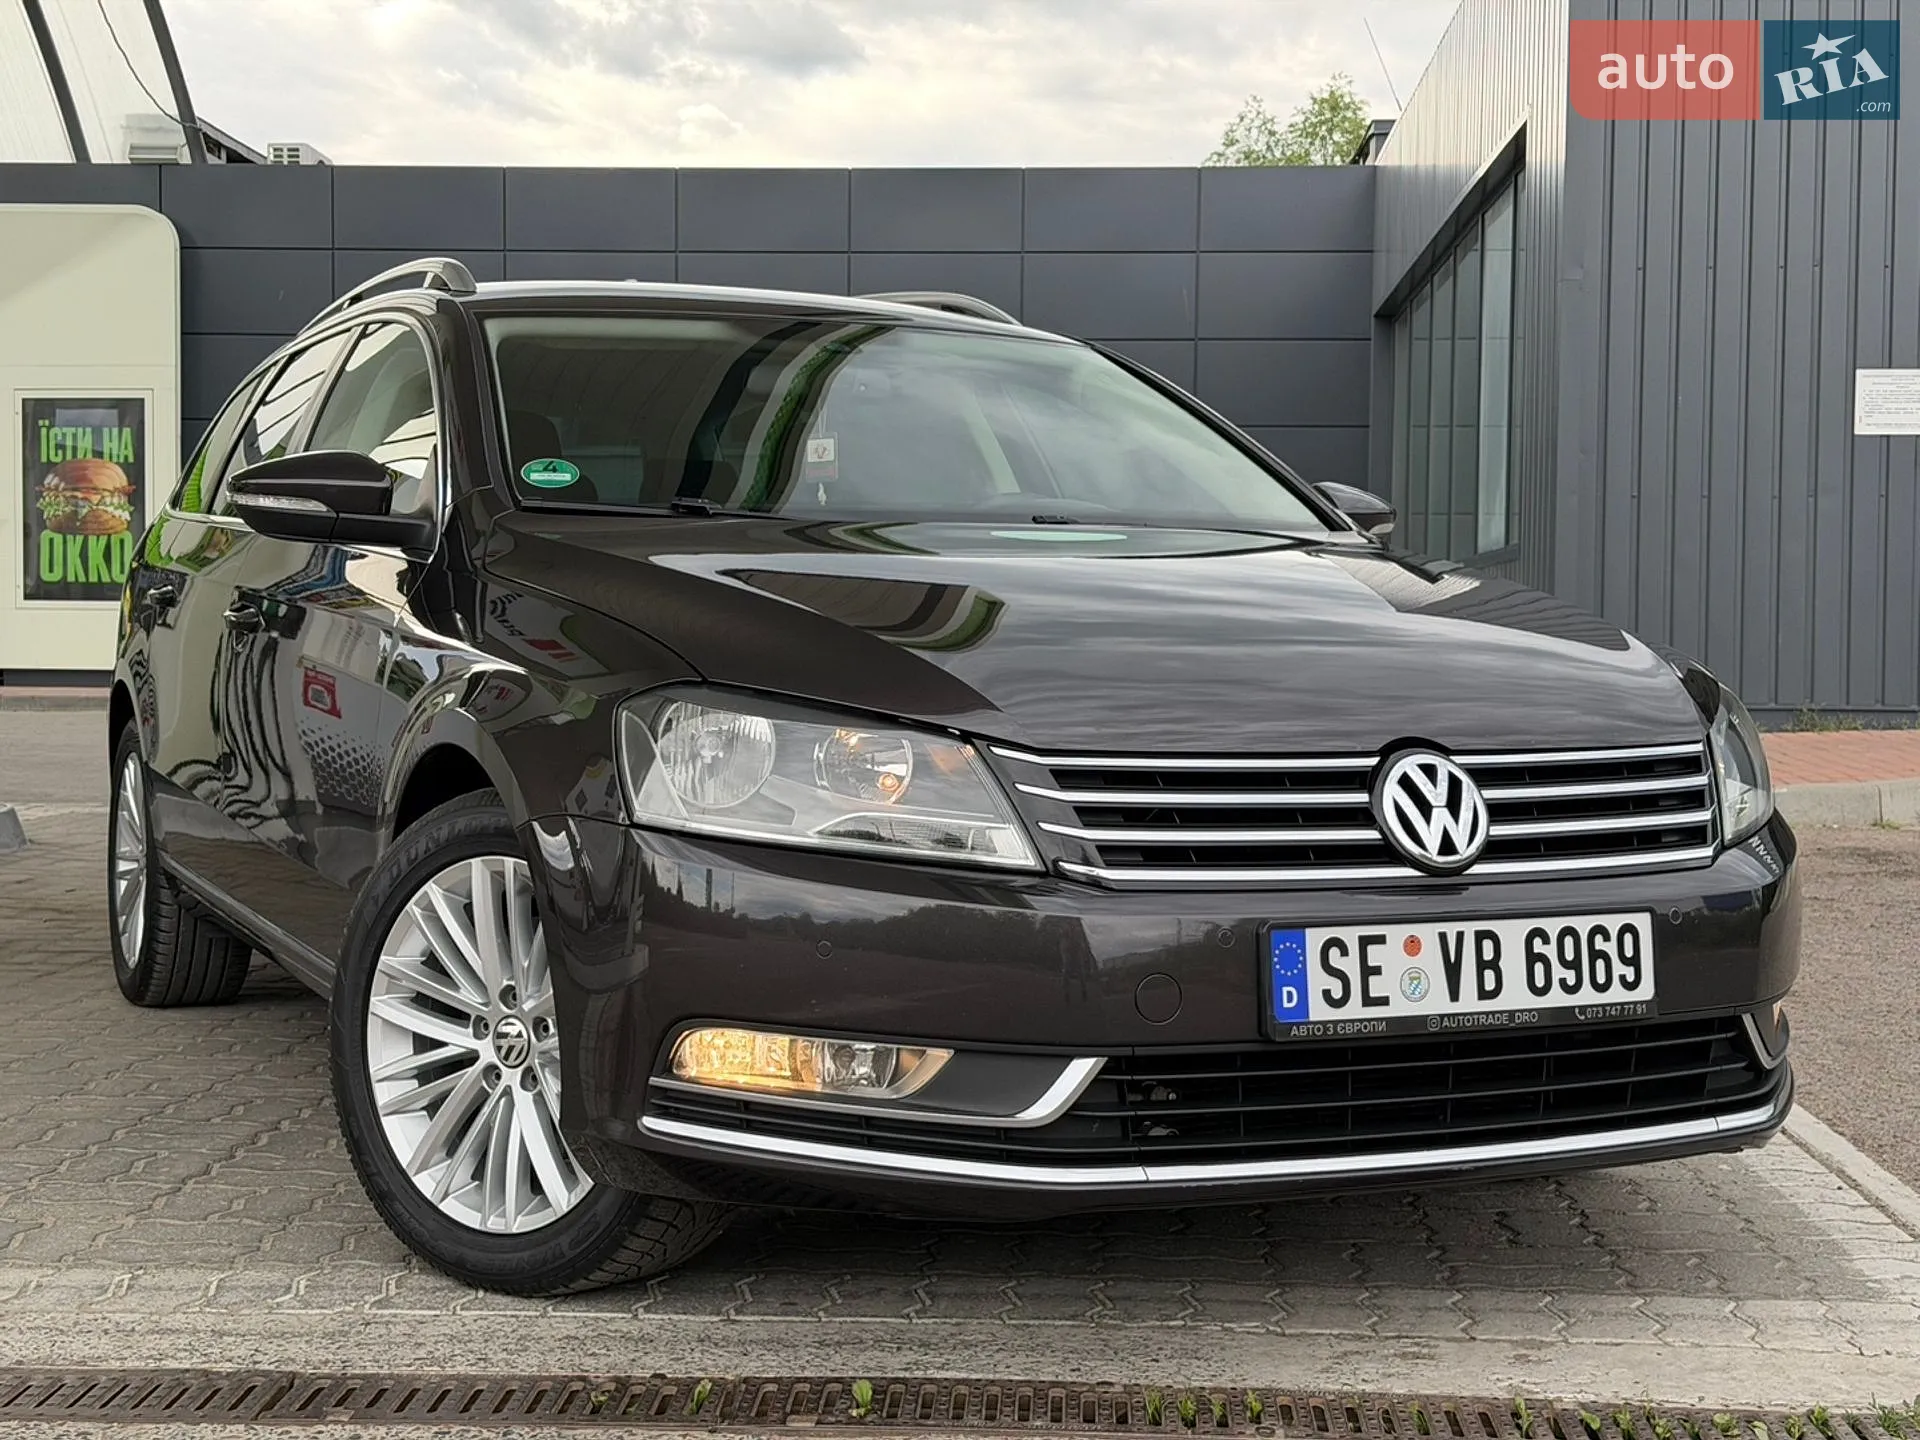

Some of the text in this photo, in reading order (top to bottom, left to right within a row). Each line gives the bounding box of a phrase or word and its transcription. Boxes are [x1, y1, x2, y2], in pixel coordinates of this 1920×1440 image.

[38, 419, 134, 463] ЇСТИ НА
[40, 529, 133, 583] ОККО
[1319, 922, 1643, 1009] SE VB 6969
[1282, 986, 1299, 1008] D
[1442, 1010, 1539, 1029] AUTOTRADE_DRO
[1586, 1006, 1603, 1018] 073
[1605, 1005, 1622, 1017] 747
[1623, 1003, 1635, 1016] 77
[1290, 1023, 1324, 1037] АВТО
[1337, 1020, 1388, 1035] ЄВРОПИ
